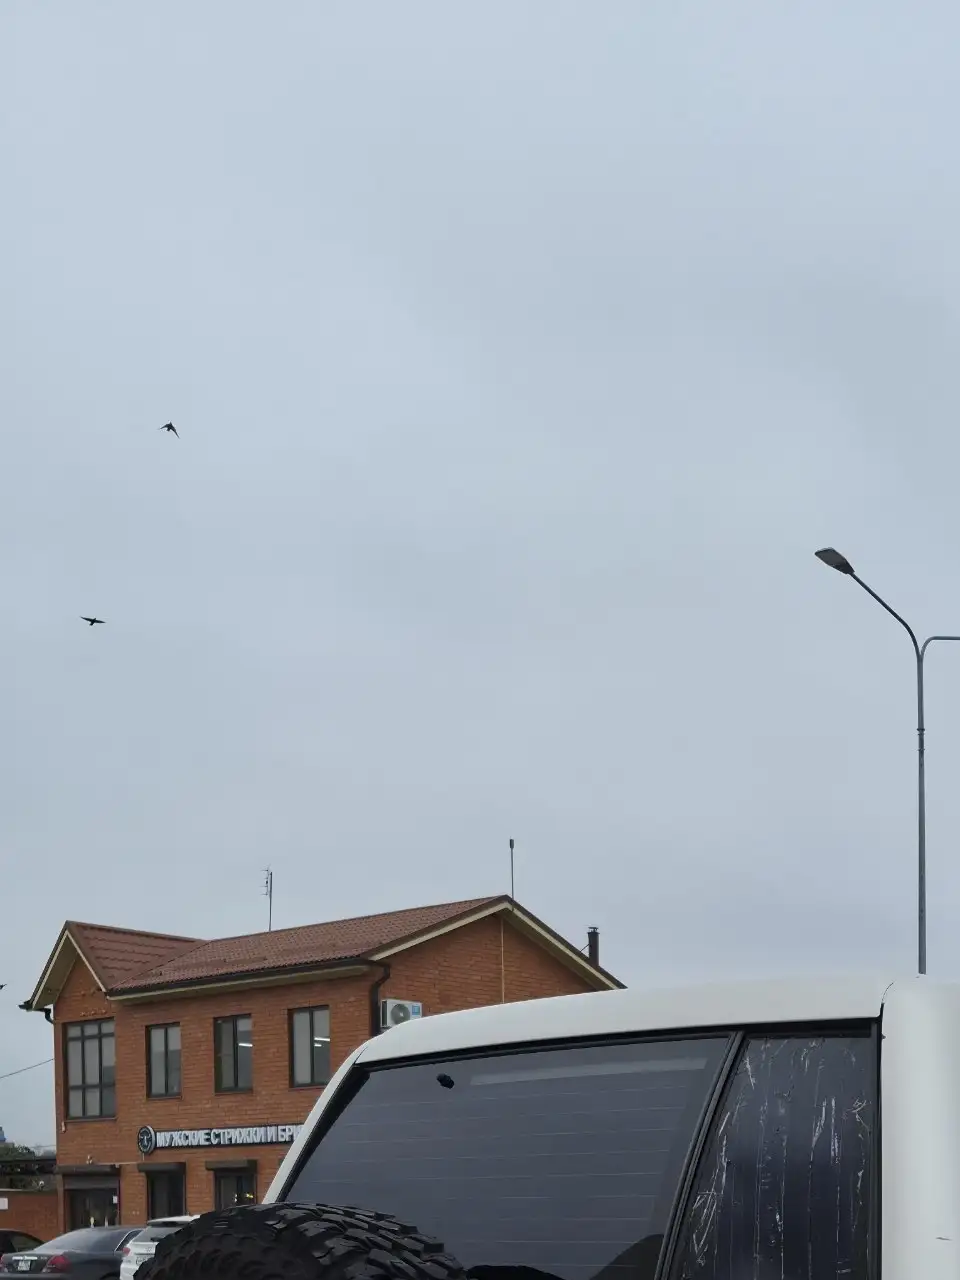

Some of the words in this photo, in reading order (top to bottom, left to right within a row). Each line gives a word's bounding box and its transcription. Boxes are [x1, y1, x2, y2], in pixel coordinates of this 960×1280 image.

[156, 1130, 211, 1147] МУЖСКИЕ
[211, 1126, 267, 1145] СТРИЖКИ
[267, 1126, 277, 1143] И
